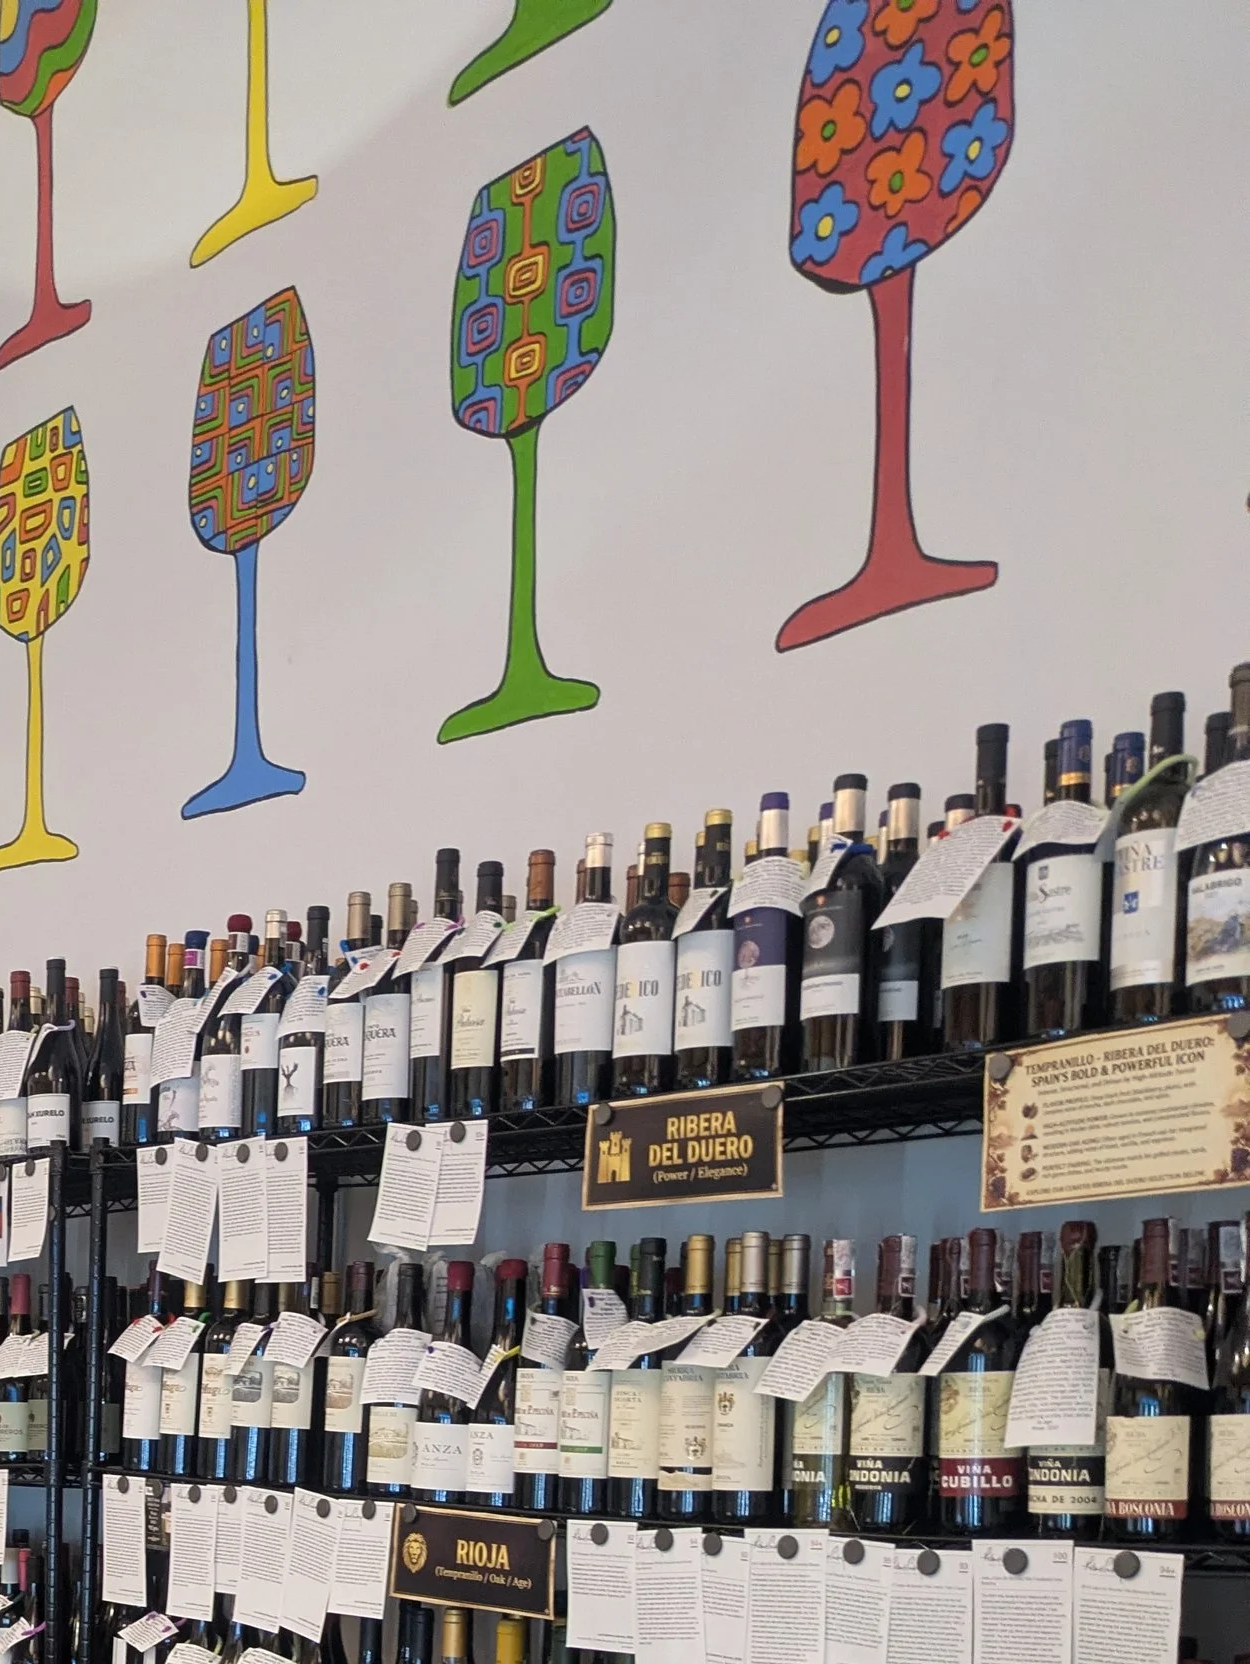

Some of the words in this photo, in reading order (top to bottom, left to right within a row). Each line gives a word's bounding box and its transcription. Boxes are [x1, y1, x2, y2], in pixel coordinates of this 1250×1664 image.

[1025, 1054, 1094, 1075] TEMPRANILLO
[1103, 1046, 1144, 1061] RIBERA
[1147, 1042, 1168, 1056] DEL
[1170, 1036, 1215, 1051] DUERO:
[1031, 1071, 1069, 1088] SPAIN'S
[1070, 1066, 1098, 1081] BOLD
[1101, 1065, 1109, 1076] &
[1111, 1056, 1173, 1074] POWERFUL
[1175, 1050, 1205, 1065] ICON
[667, 1111, 737, 1139] RIBERA
[649, 1143, 683, 1167] DEL
[688, 1135, 753, 1163] DUERO
[653, 1170, 688, 1184] (Power
[697, 1163, 748, 1179] Elegance)
[856, 1457, 883, 1469] VIÑA
[957, 1462, 992, 1474] VIÑA
[1038, 1458, 1062, 1468] VIÑA
[941, 1473, 1013, 1488] CUBILLO
[1052, 1494, 1066, 1503] DE
[1118, 1500, 1176, 1516] BOSCONIA
[456, 1539, 510, 1571] RIOJA
[435, 1566, 483, 1582] (Tempranillo
[489, 1574, 506, 1586] Oak
[512, 1577, 532, 1590] Age)
